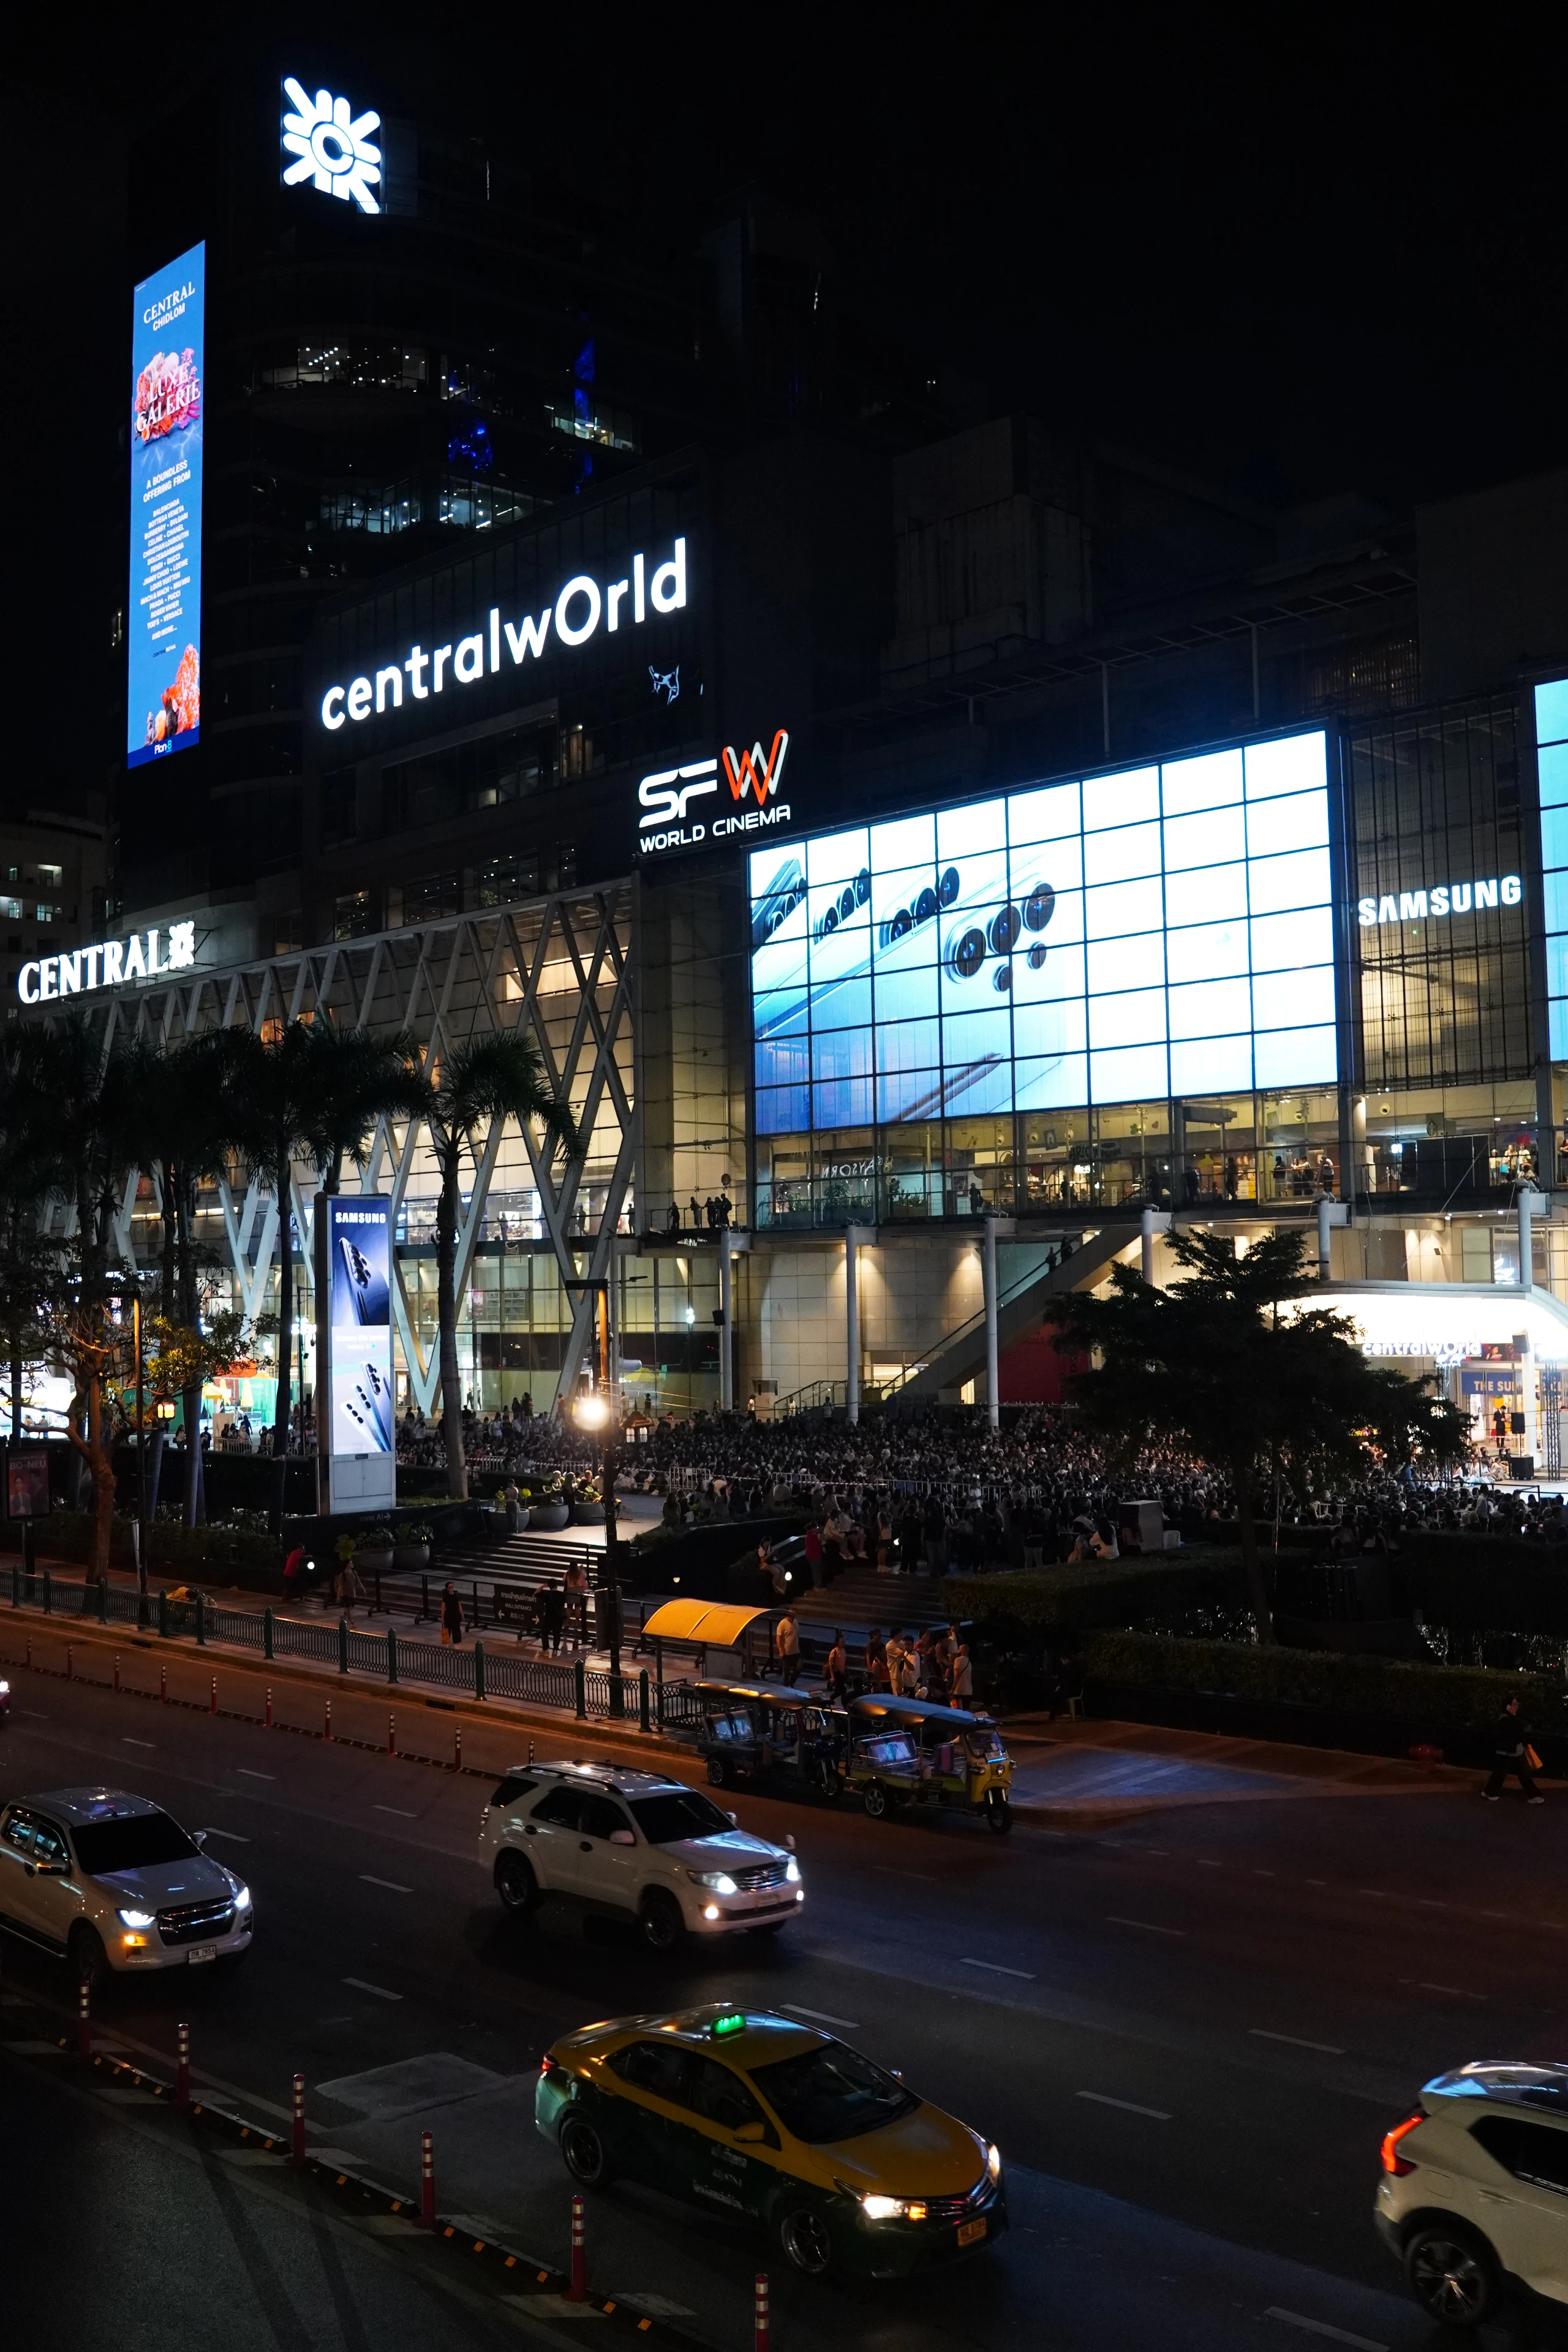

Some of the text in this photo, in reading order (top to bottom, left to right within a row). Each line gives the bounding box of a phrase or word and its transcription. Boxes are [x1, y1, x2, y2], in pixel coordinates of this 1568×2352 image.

[143, 281, 195, 323] CENTRAL
[153, 303, 186, 331] CHIDLOM
[149, 363, 190, 403] LUXE
[137, 379, 201, 432] GALERIE
[143, 469, 190, 502] OFFERING FROM
[146, 459, 187, 489] A BOUNDLESS
[640, 805, 791, 853] WORLD CINEMA
[1358, 875, 1521, 926] SAMSUNG
[18, 929, 169, 1004] CENTRAL
[335, 1212, 386, 1224] SAMSUNG
[1474, 1381, 1494, 1392] THE
